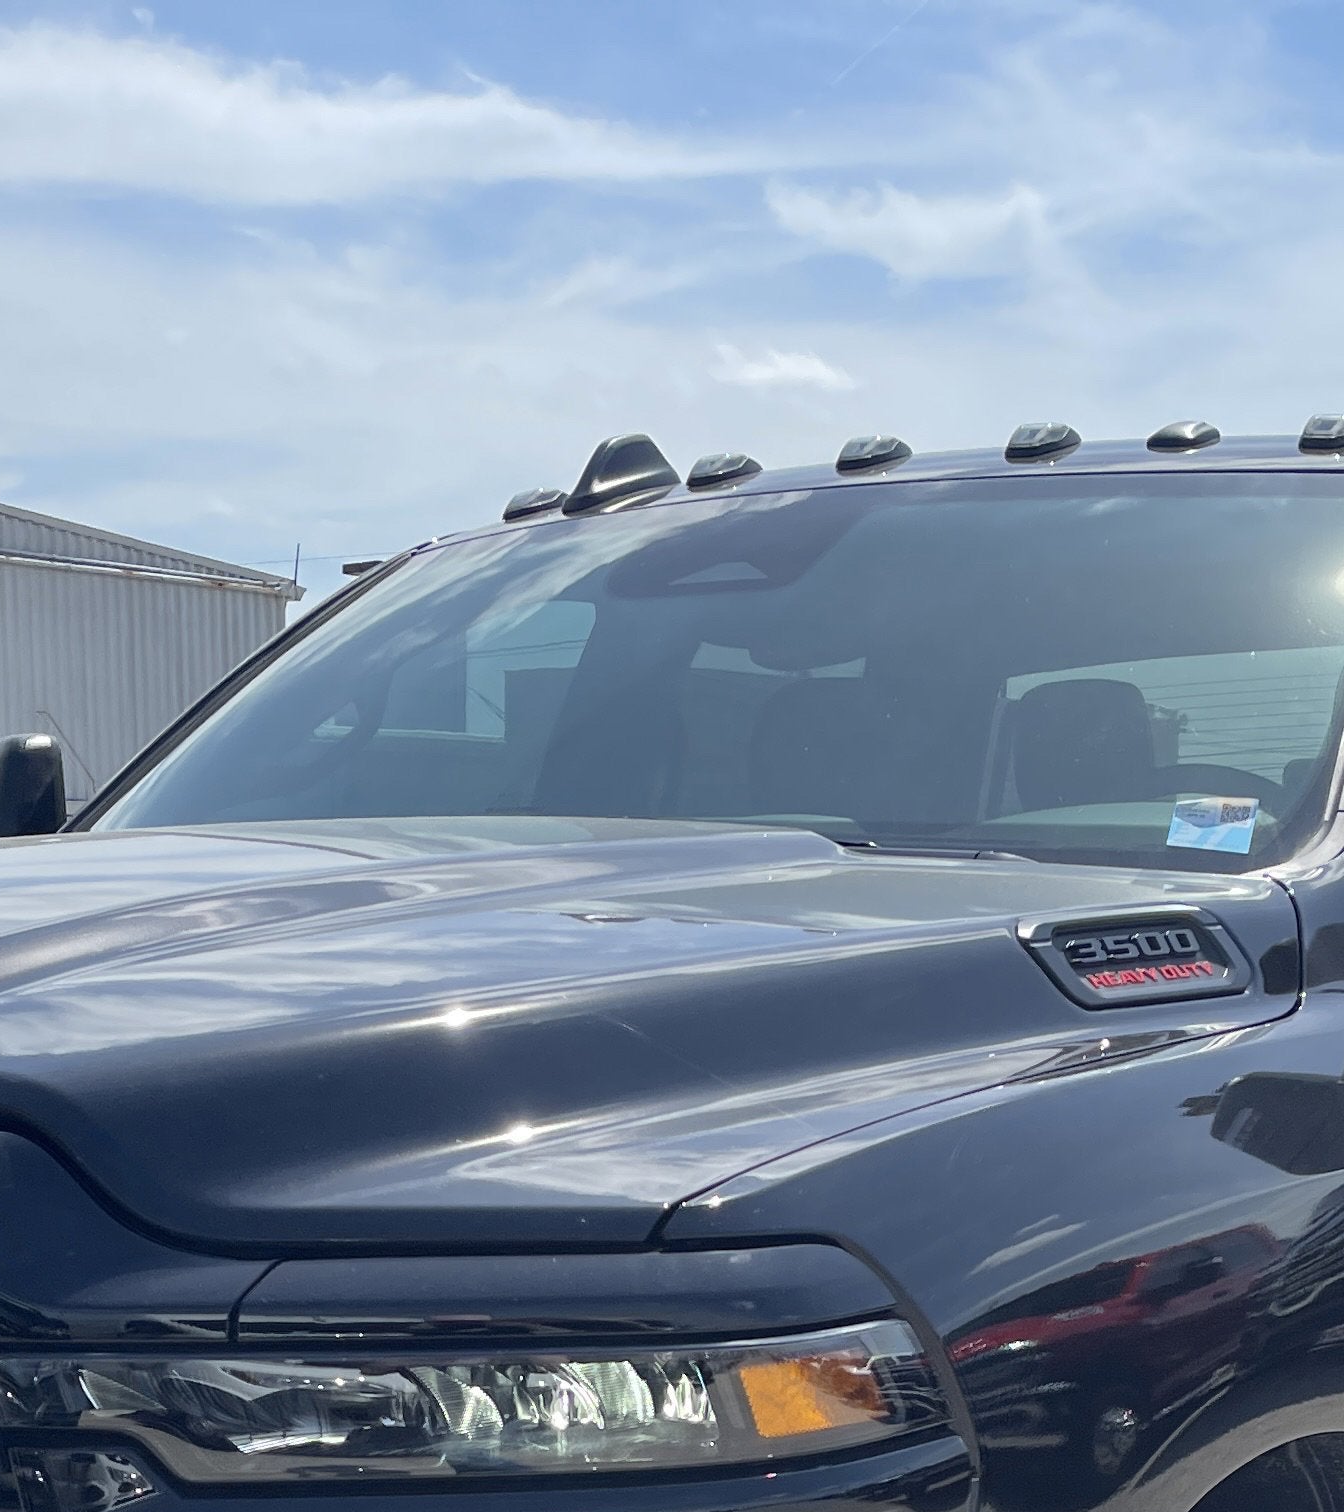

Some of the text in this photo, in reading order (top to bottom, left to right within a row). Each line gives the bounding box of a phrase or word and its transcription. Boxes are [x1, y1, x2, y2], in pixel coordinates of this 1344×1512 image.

[1065, 928, 1201, 964] 3500
[1085, 960, 1214, 989] HEAVY DUTY
